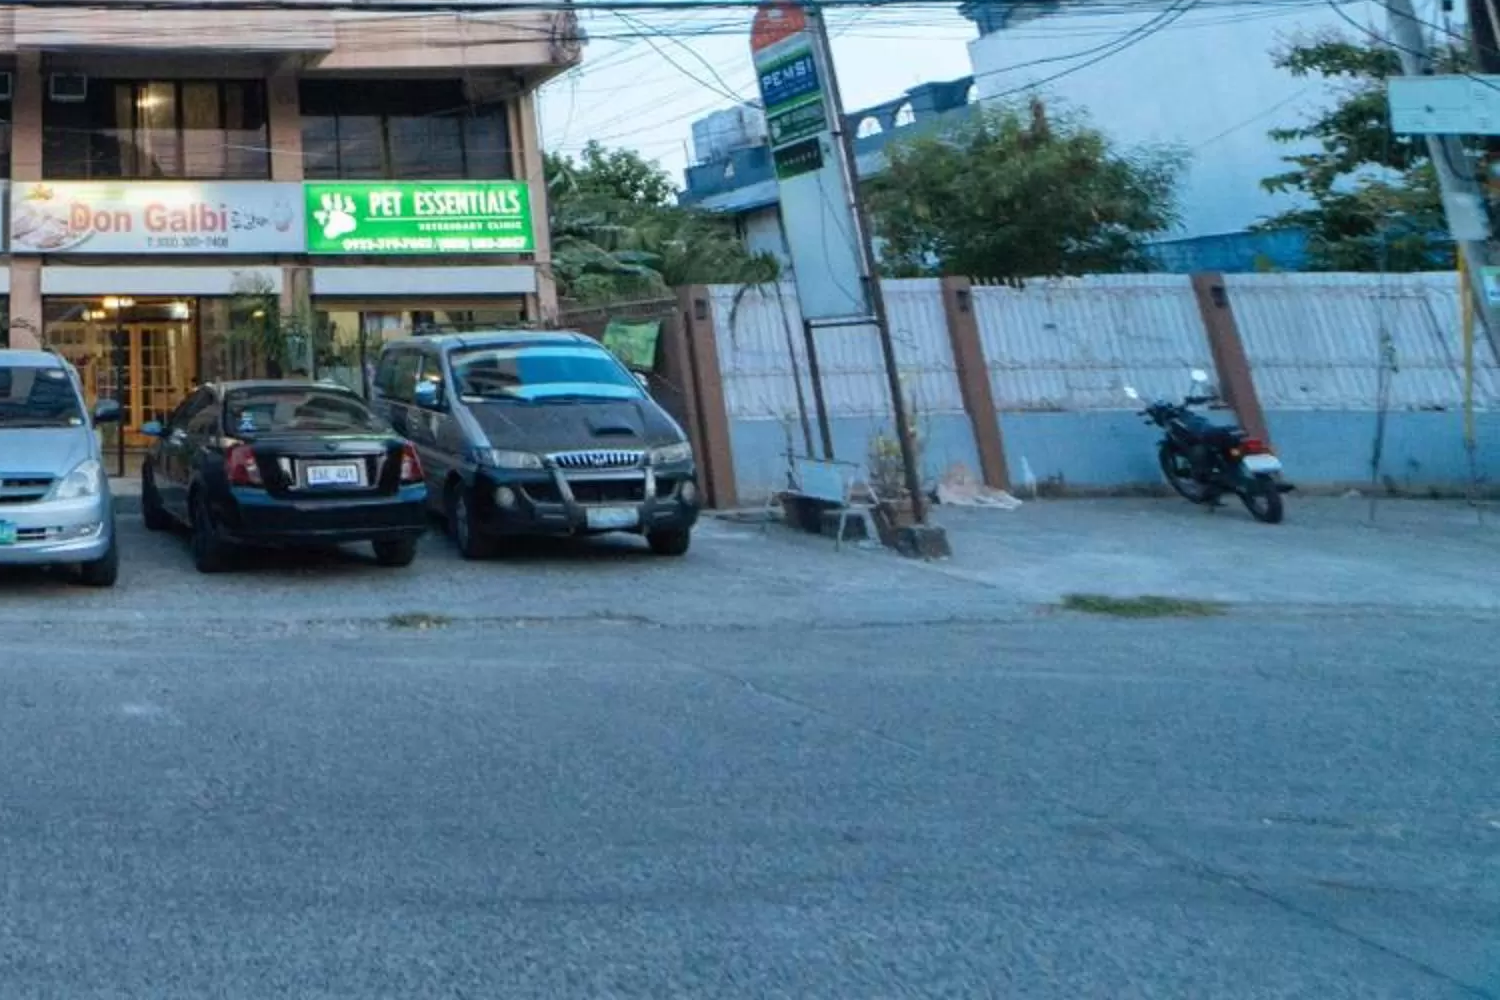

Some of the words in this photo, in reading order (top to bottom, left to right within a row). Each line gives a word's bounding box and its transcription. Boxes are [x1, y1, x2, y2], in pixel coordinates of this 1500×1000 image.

[368, 191, 403, 216] PET
[414, 190, 521, 216] ESSENTIALS
[69, 203, 132, 233] Don
[143, 202, 228, 233] Galbi
